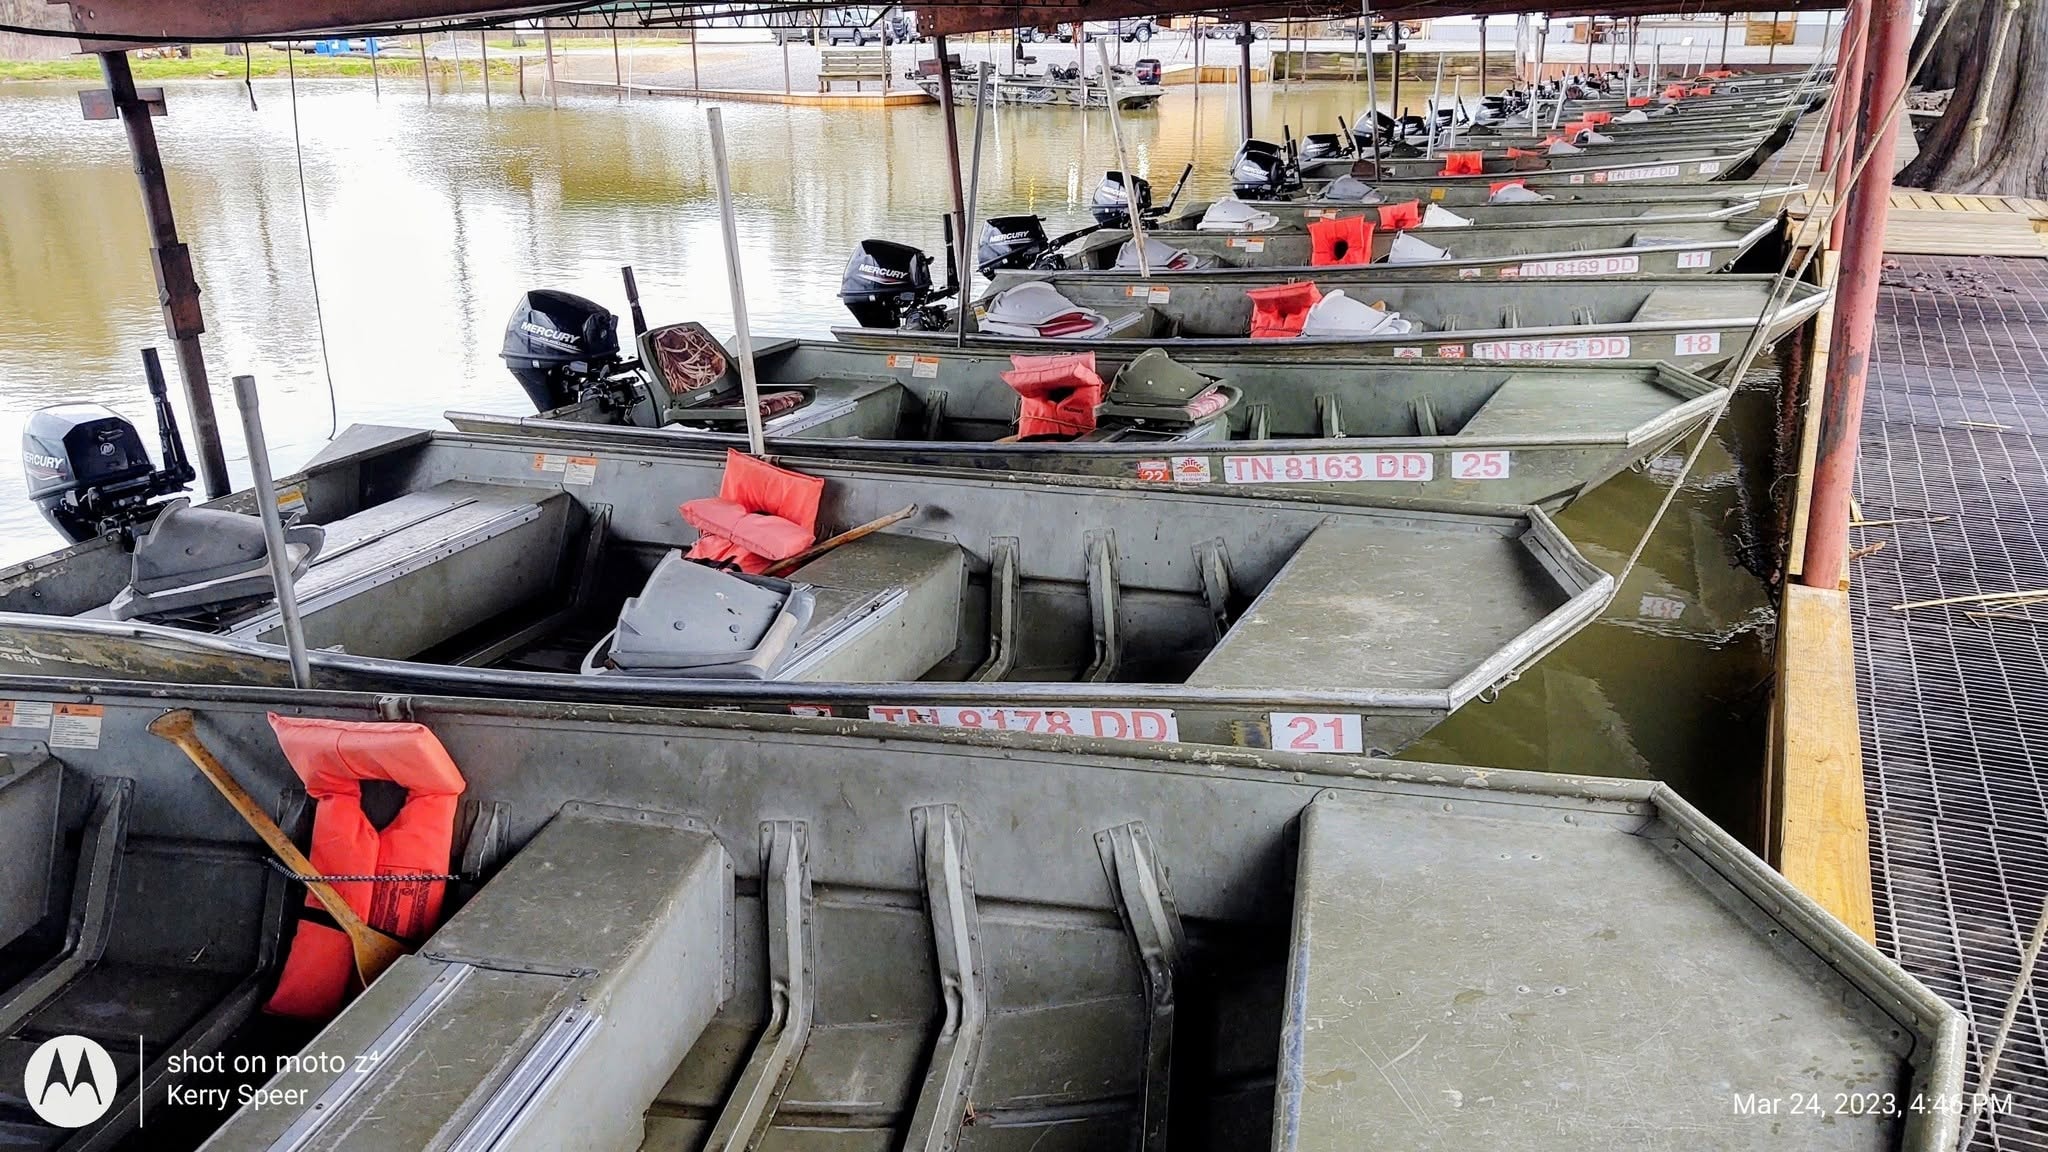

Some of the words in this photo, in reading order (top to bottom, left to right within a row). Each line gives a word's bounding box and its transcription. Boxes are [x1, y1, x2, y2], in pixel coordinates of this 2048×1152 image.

[989, 230, 1030, 243] MERCURY
[1522, 263, 1548, 276] TN
[1554, 260, 1600, 275] 8169
[1606, 257, 1635, 272] DD
[1685, 253, 1705, 266] 11
[858, 263, 909, 279] MERCURY
[520, 321, 581, 344] MERCURY
[1477, 343, 1511, 359] TN
[1519, 340, 1579, 358] 8175
[1587, 338, 1626, 357] DD
[1683, 335, 1713, 353] 18
[24, 451, 65, 469] ERCURY
[1228, 457, 1274, 481] TN
[1284, 455, 1364, 480] 8163
[1375, 453, 1429, 479] DD
[1461, 453, 1502, 478] 25
[873, 707, 941, 725] TN
[957, 709, 1075, 736] 8178
[1091, 710, 1168, 742] DD
[1288, 716, 1345, 750] 21
